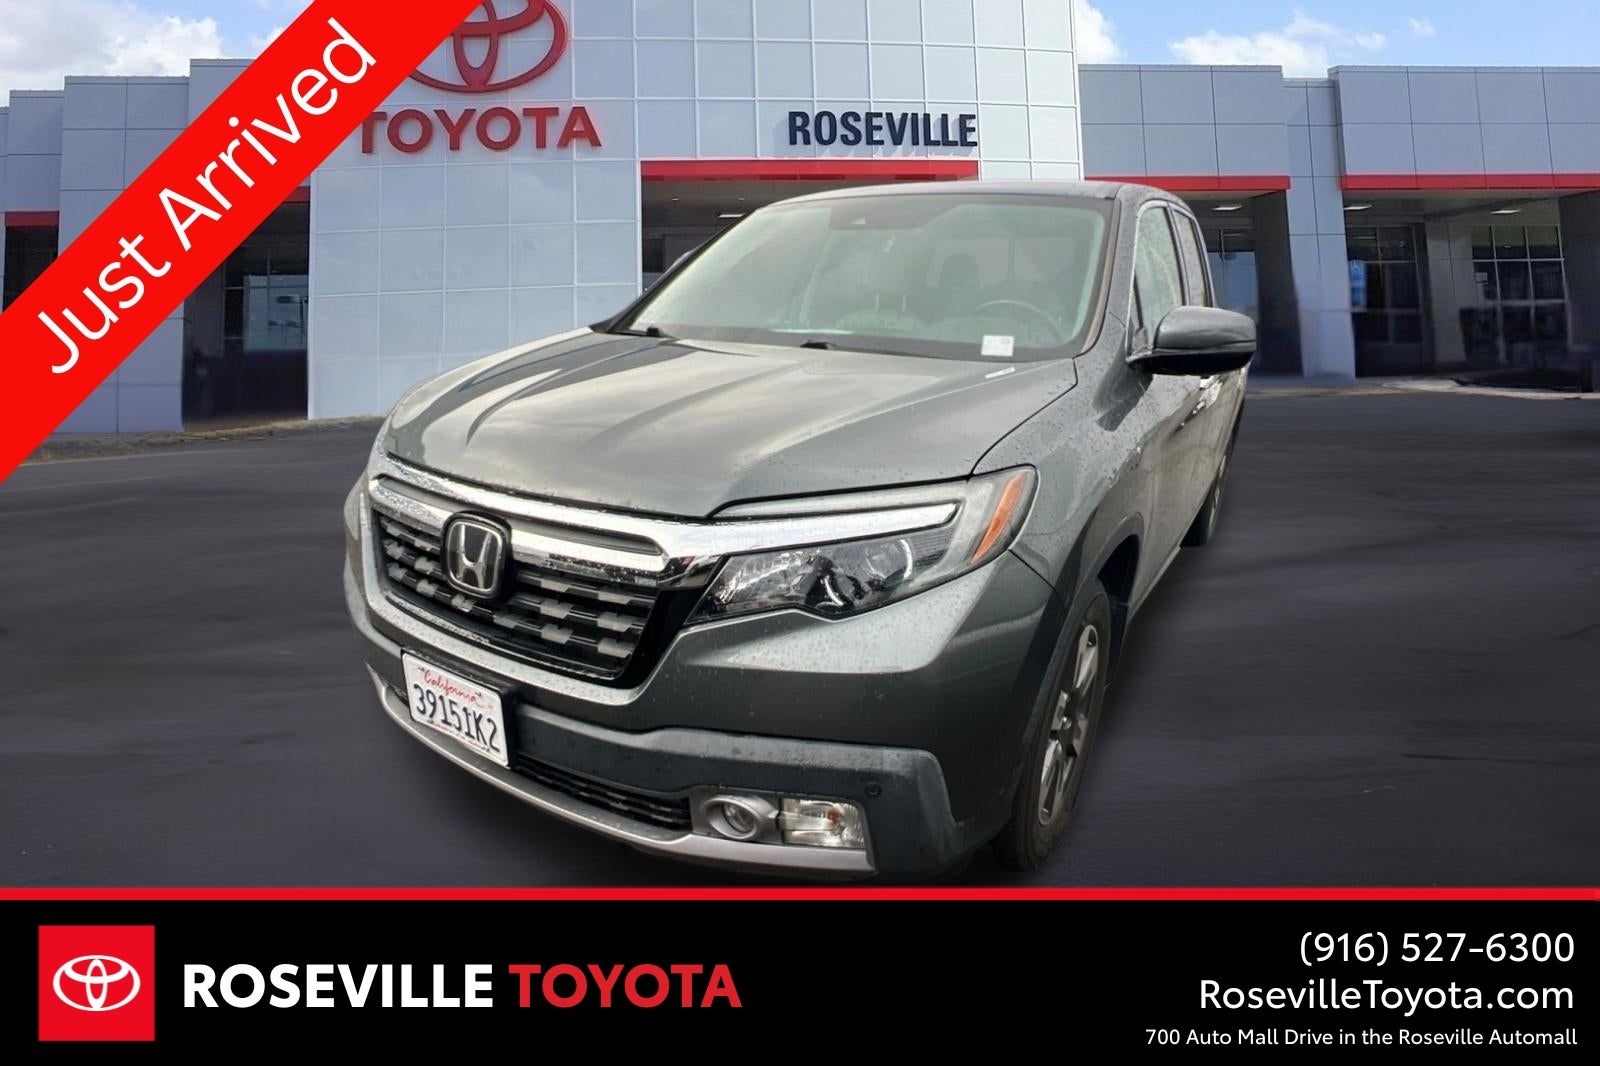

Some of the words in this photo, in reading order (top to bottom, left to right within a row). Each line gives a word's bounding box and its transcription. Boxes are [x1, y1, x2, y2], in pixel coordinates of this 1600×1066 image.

[361, 106, 602, 153] TOYOTA
[788, 110, 978, 148] ROSEVILLE
[423, 669, 484, 707] California
[413, 683, 500, 754] 39151K2
